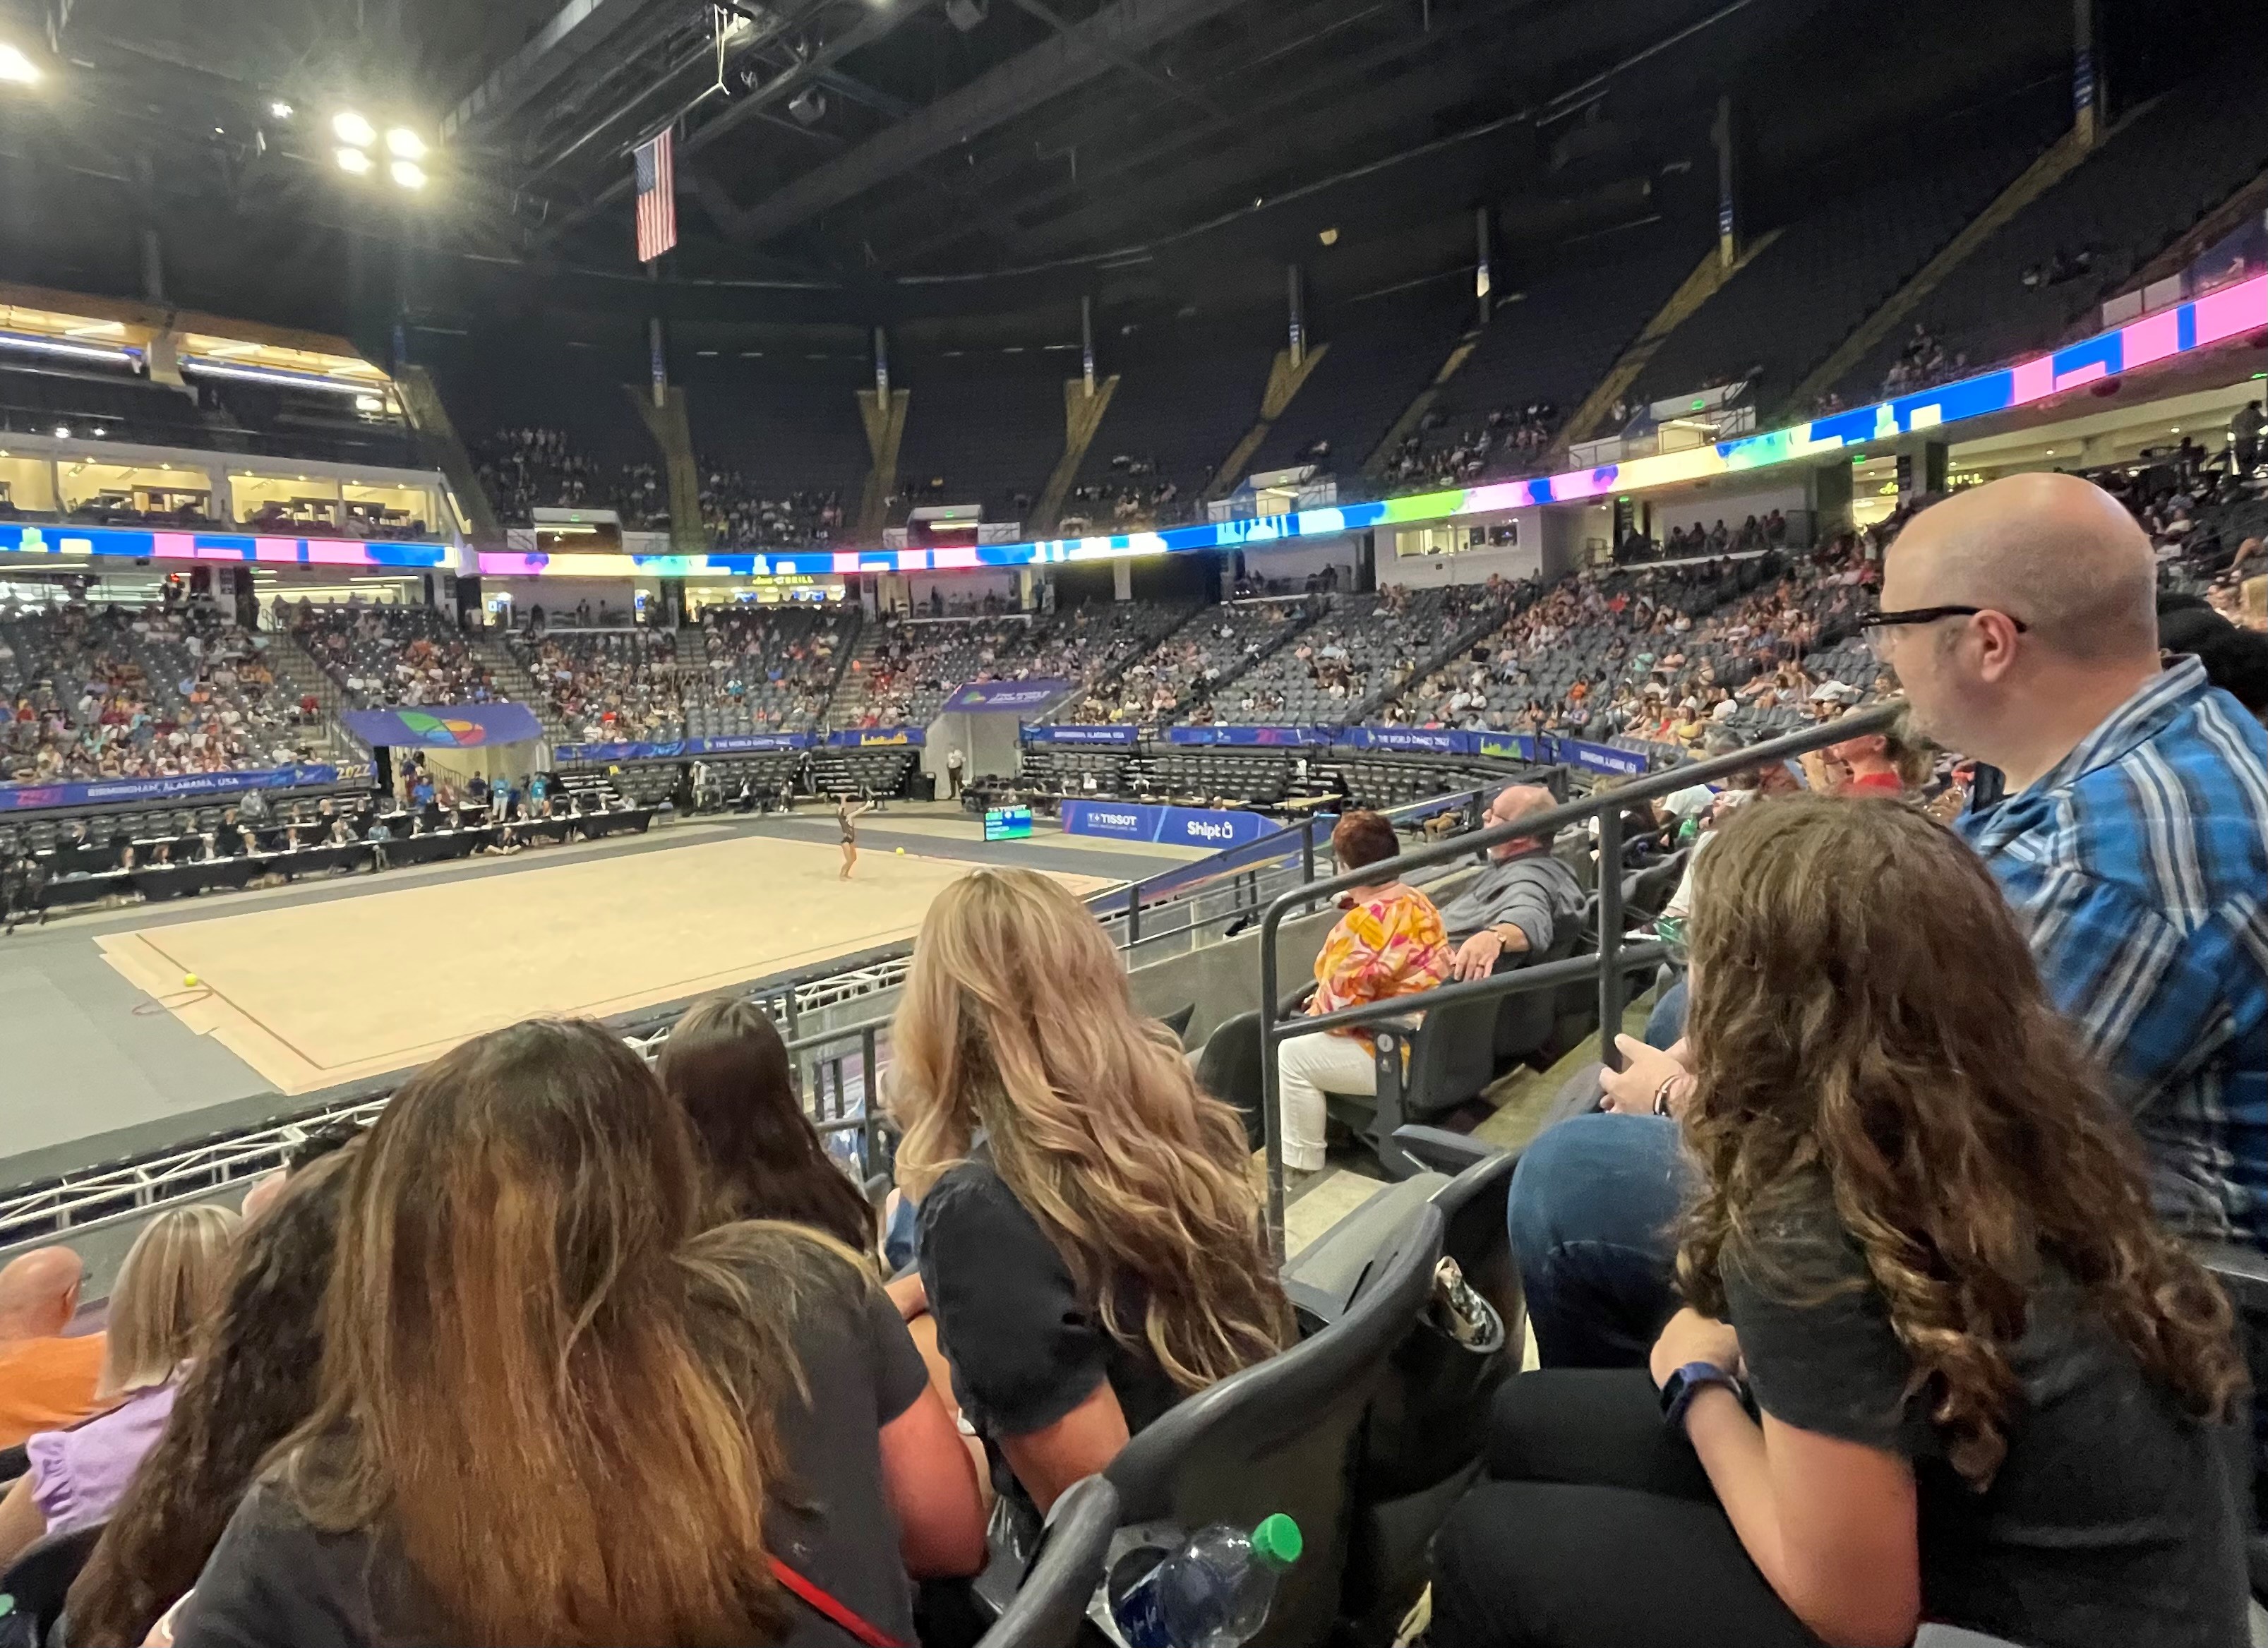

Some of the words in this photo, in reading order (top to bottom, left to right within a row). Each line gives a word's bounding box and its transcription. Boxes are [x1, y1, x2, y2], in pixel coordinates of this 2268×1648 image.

[336, 764, 372, 781] 2022
[217, 778, 239, 786] USA
[1100, 813, 1137, 826] TISSOT
[1187, 820, 1221, 841] Shipt
